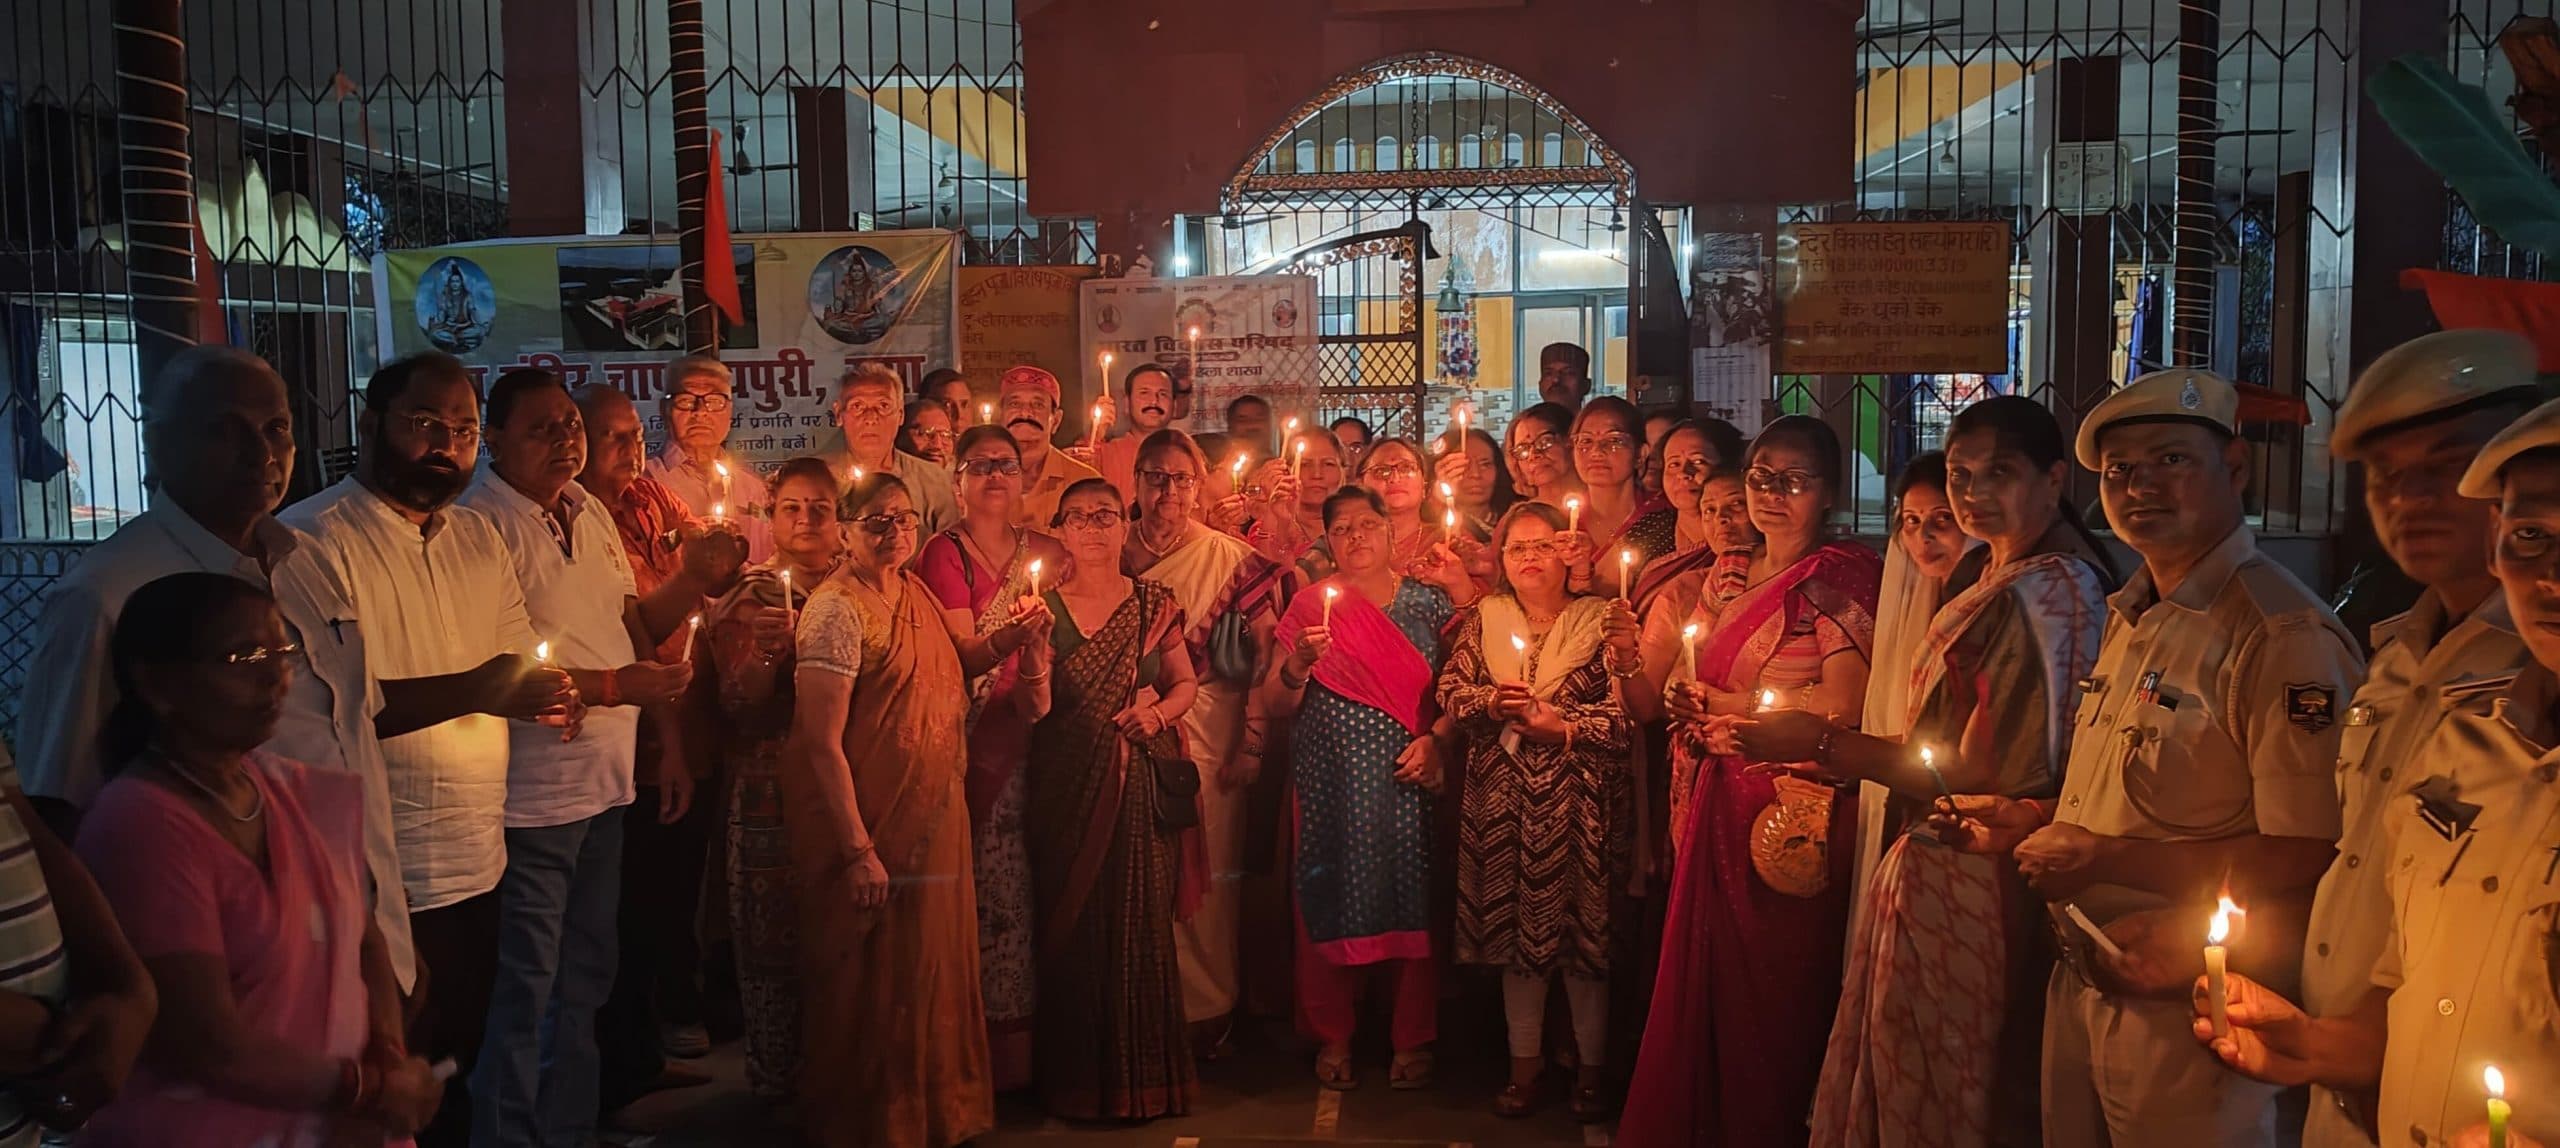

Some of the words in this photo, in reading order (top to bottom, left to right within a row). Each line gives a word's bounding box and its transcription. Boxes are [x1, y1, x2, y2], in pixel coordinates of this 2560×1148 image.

[1226, 364, 1264, 377] शाखा
[750, 412, 794, 429] प्रगति
[801, 415, 822, 428] पर
[736, 434, 776, 450] भागी
